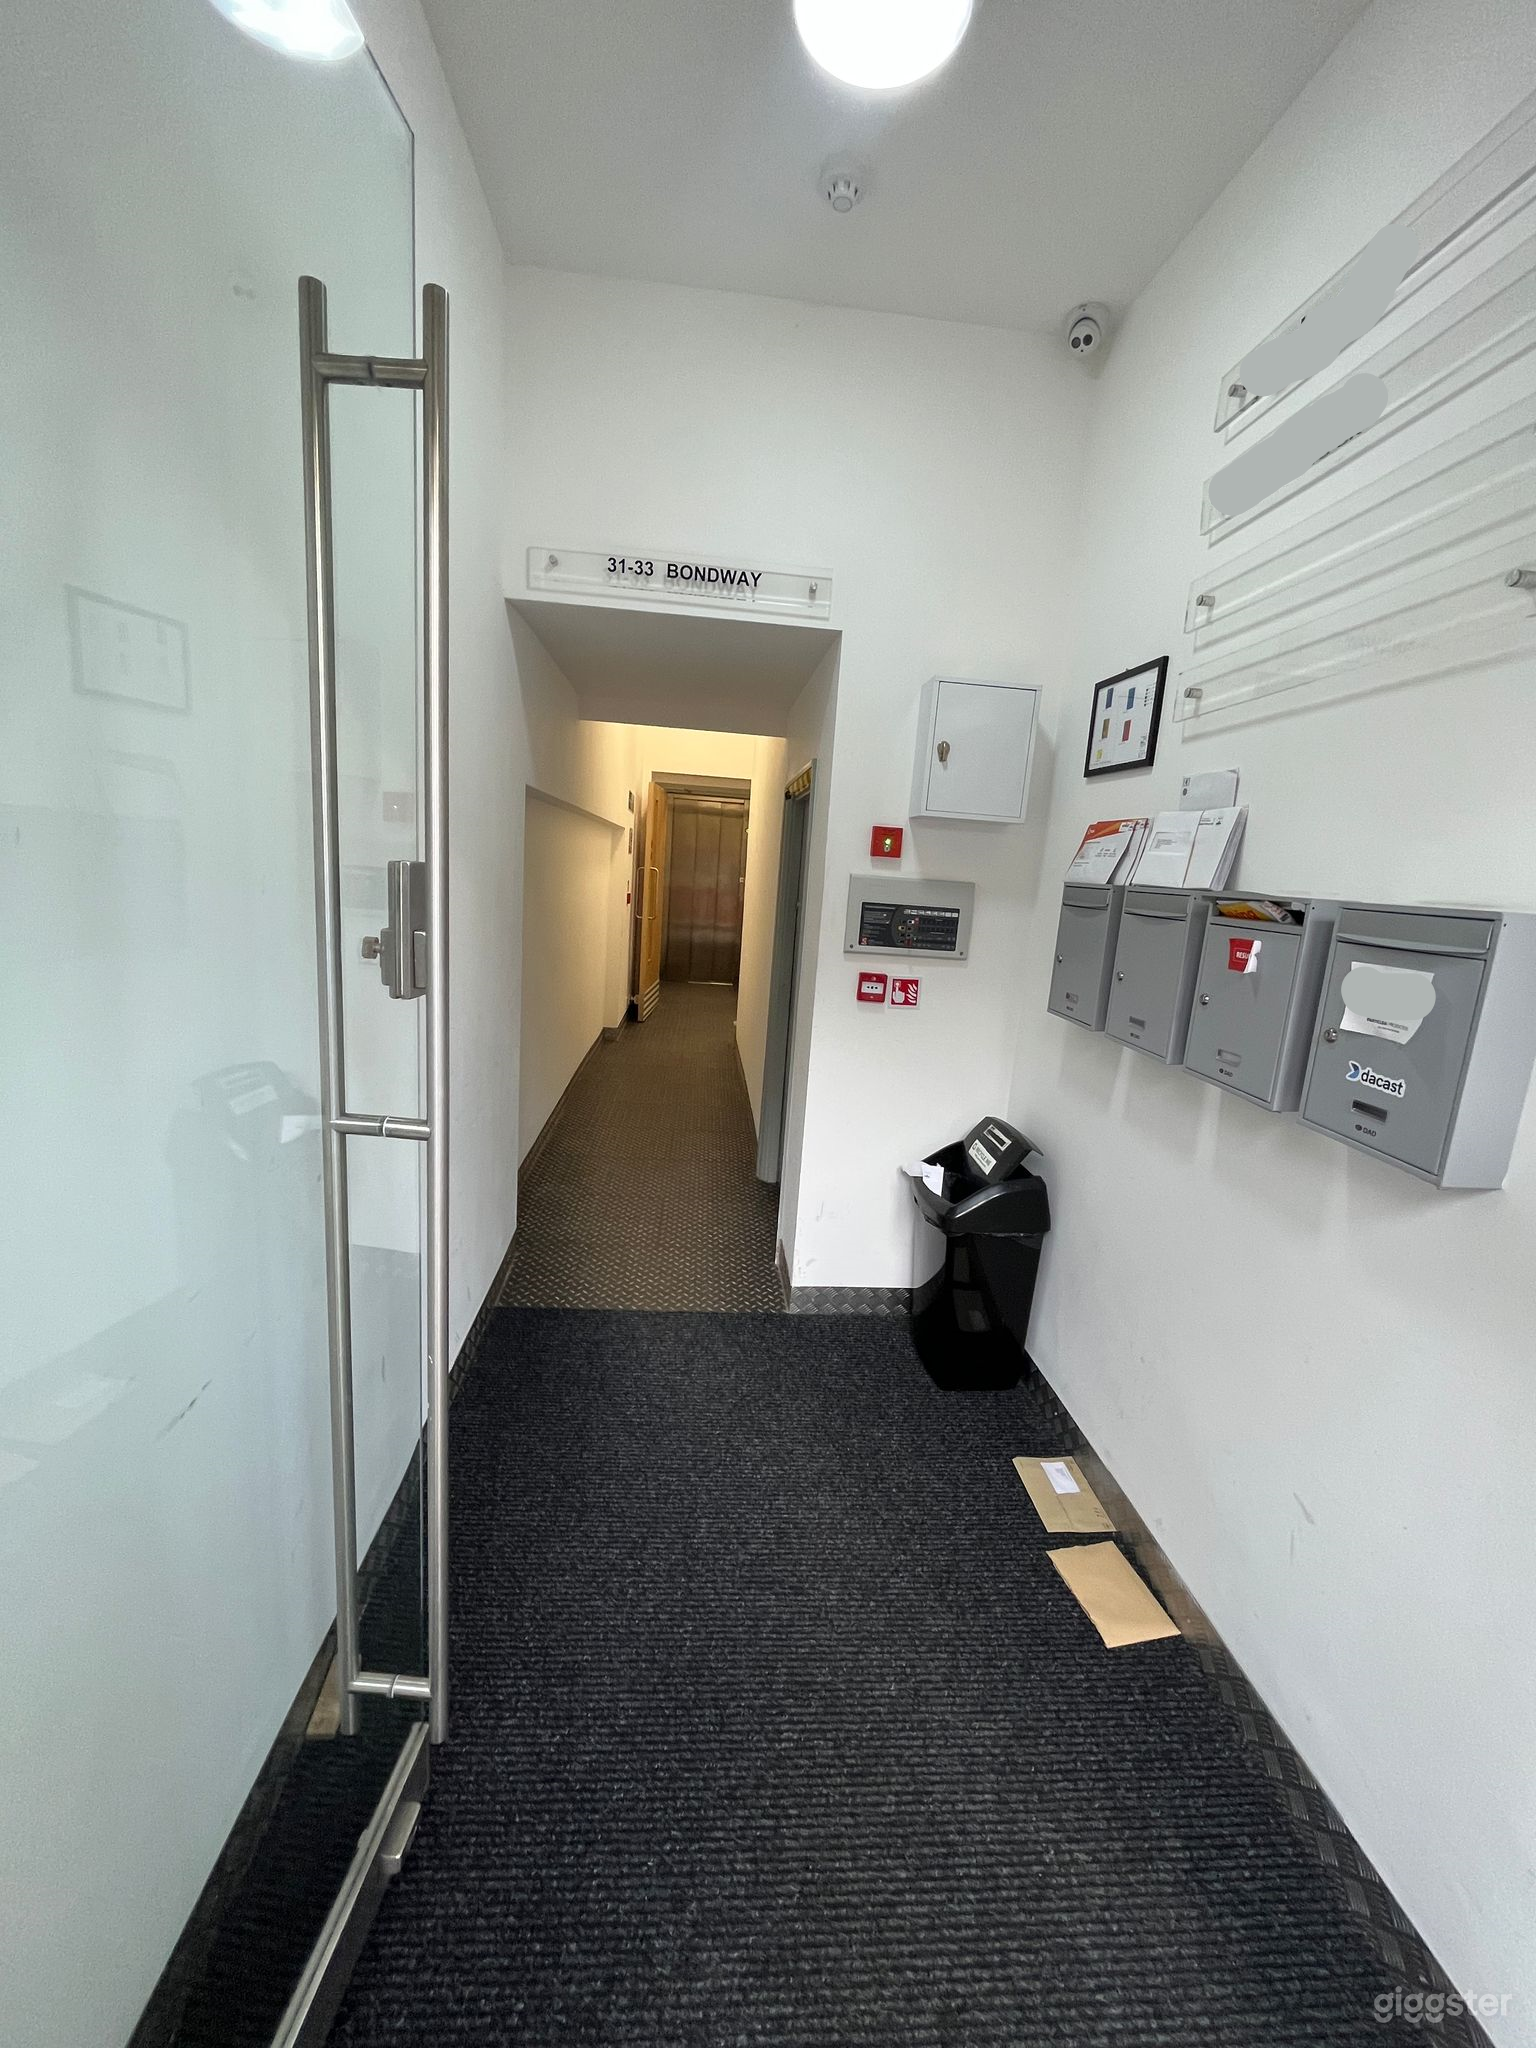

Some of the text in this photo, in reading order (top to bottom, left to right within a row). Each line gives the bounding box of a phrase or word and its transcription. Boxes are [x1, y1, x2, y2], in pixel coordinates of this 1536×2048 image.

[608, 557, 762, 587] 31-33 BONDWAY
[1361, 1070, 1403, 1095] dacast
